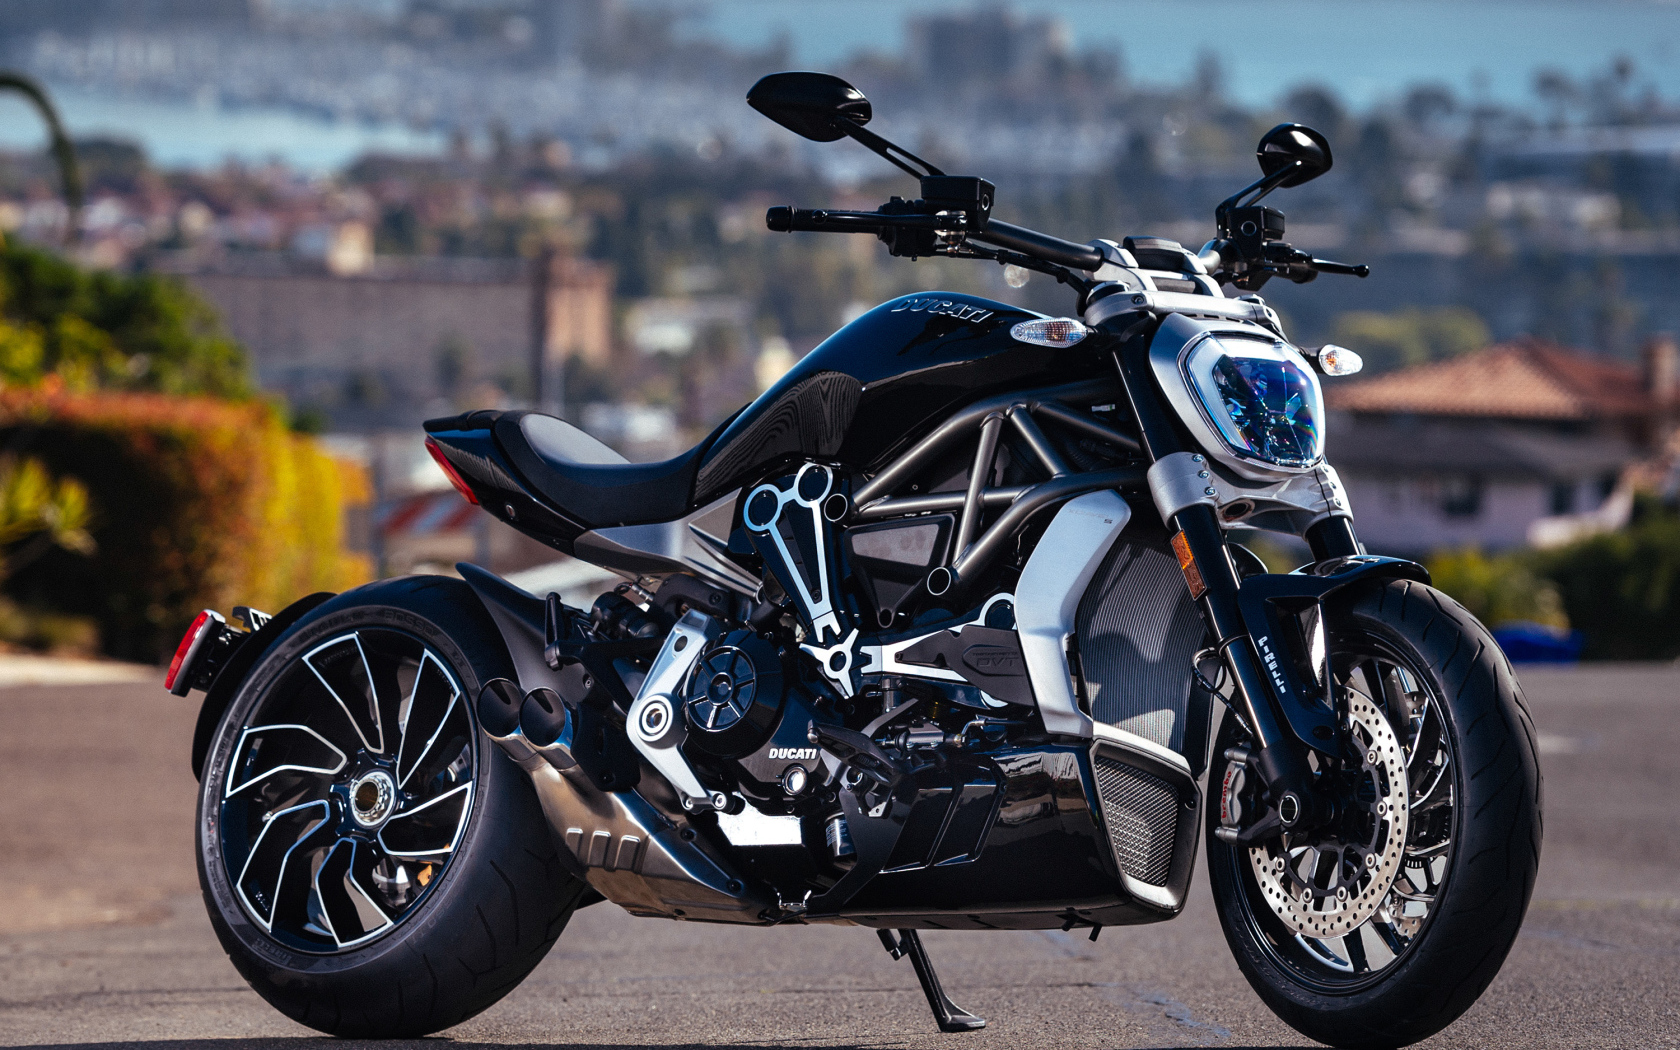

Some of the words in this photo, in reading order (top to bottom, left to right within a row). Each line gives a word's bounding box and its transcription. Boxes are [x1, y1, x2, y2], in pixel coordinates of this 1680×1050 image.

[891, 298, 994, 323] DUCATI
[976, 656, 1020, 667] DVT
[1258, 635, 1287, 694] PIRELLI
[768, 748, 817, 760] DUCATI
[1221, 771, 1232, 818] brembo
